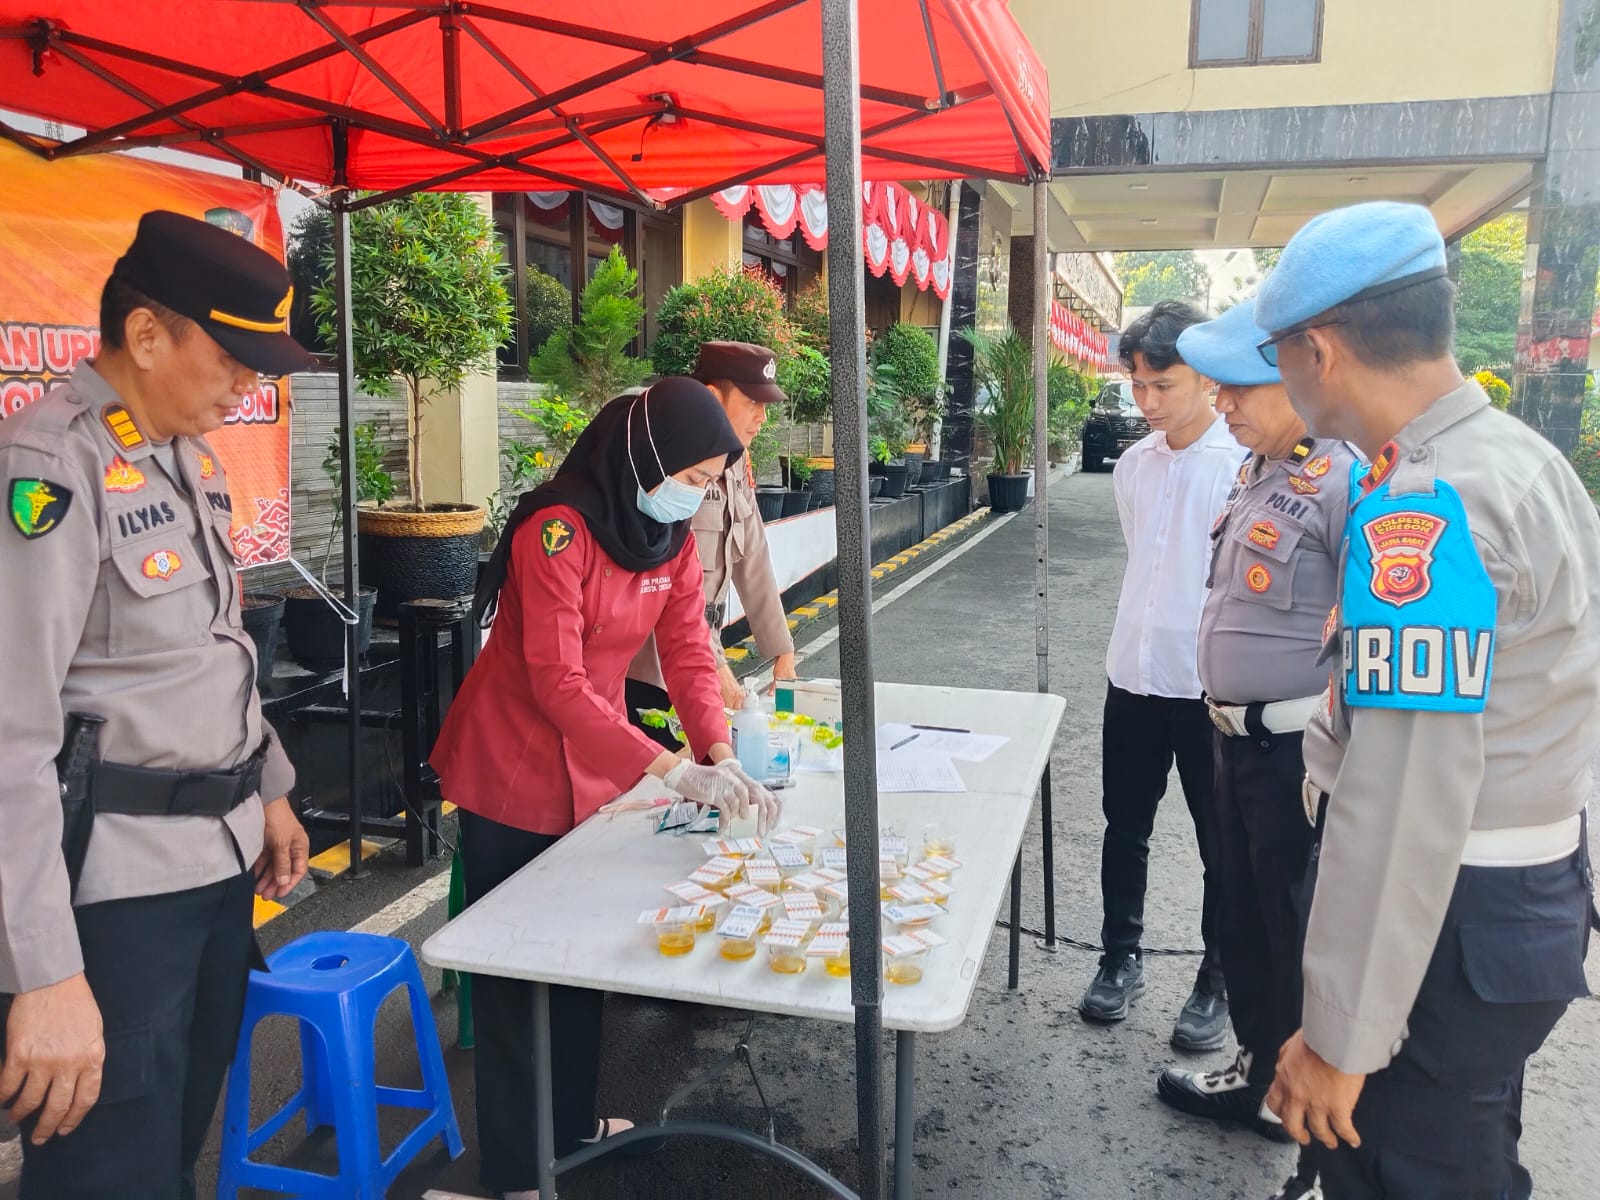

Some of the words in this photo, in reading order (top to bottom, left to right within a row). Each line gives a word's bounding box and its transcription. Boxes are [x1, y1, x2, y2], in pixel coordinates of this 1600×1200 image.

[1265, 492, 1309, 520] POLRI
[118, 501, 175, 538] ILYAS
[1373, 517, 1434, 532] POLRESTA
[1376, 524, 1431, 535] CIREBON
